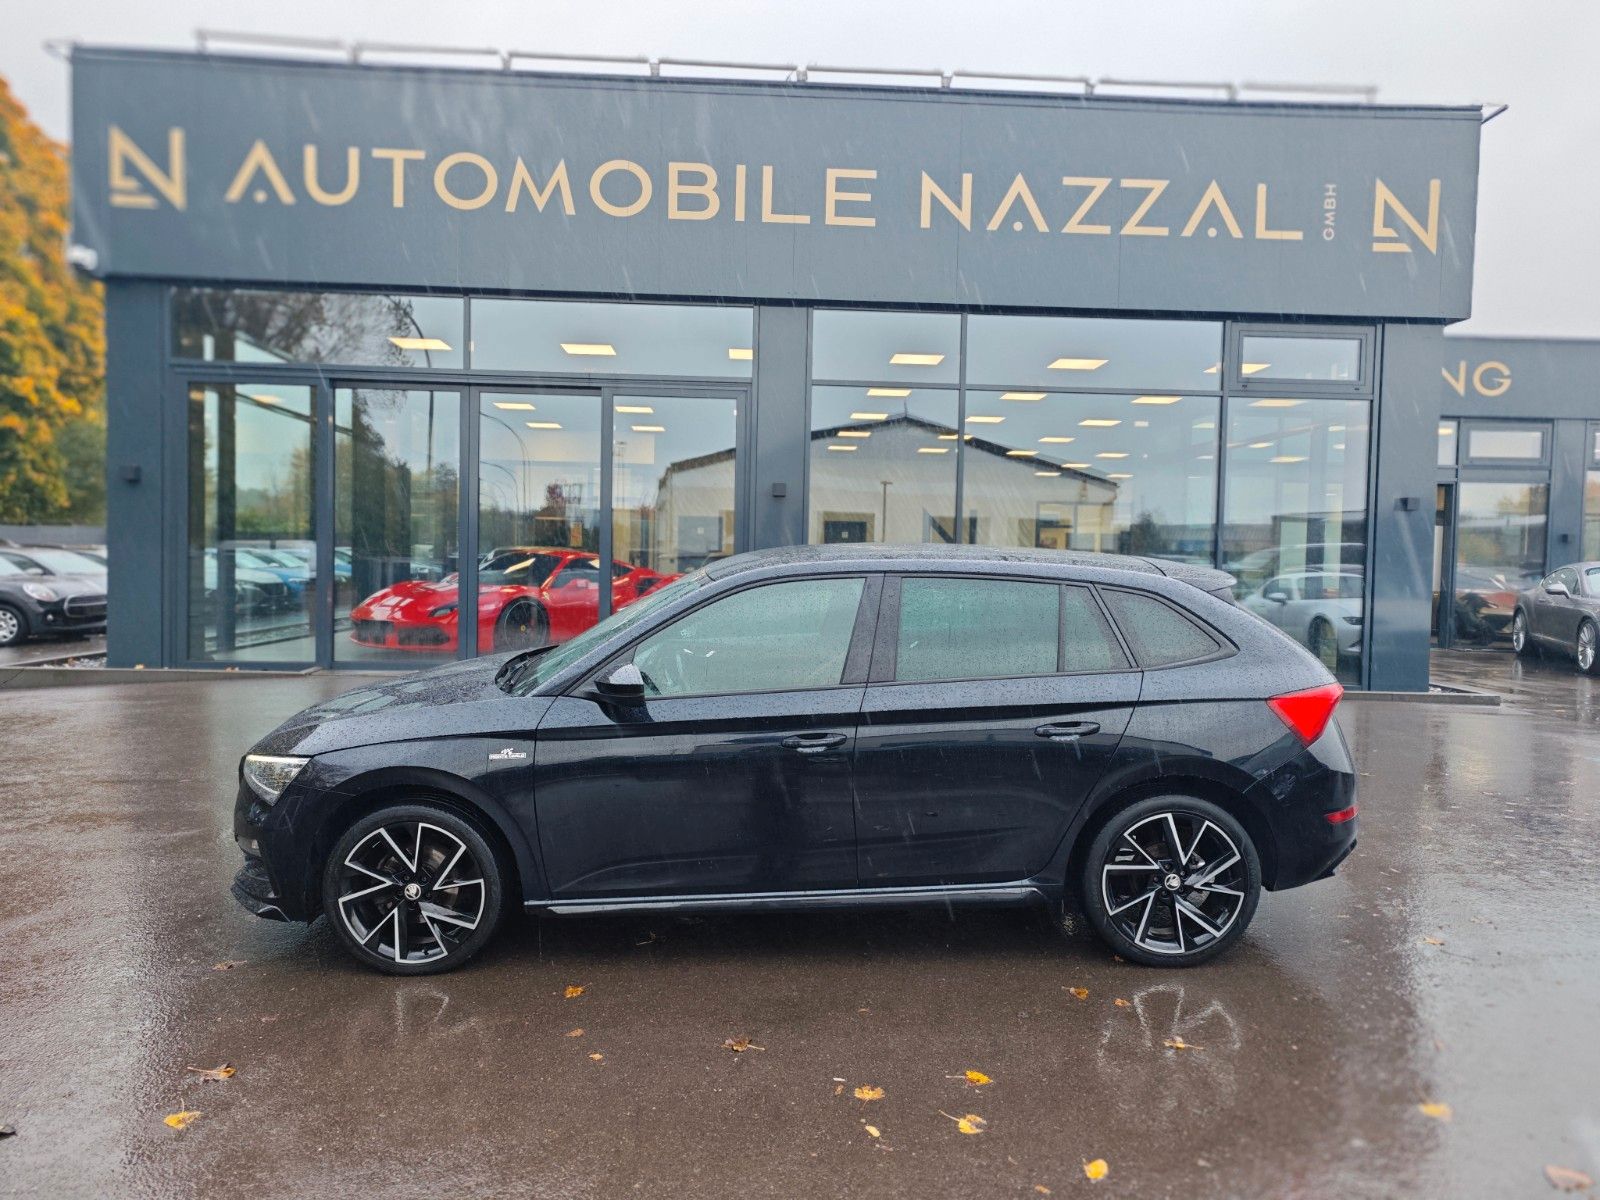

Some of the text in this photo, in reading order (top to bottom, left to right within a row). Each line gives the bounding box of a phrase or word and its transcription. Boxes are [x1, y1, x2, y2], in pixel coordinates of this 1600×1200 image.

[227, 141, 1304, 241] AUTOMOBILE NAZZAL
[1322, 183, 1337, 241] GMBH
